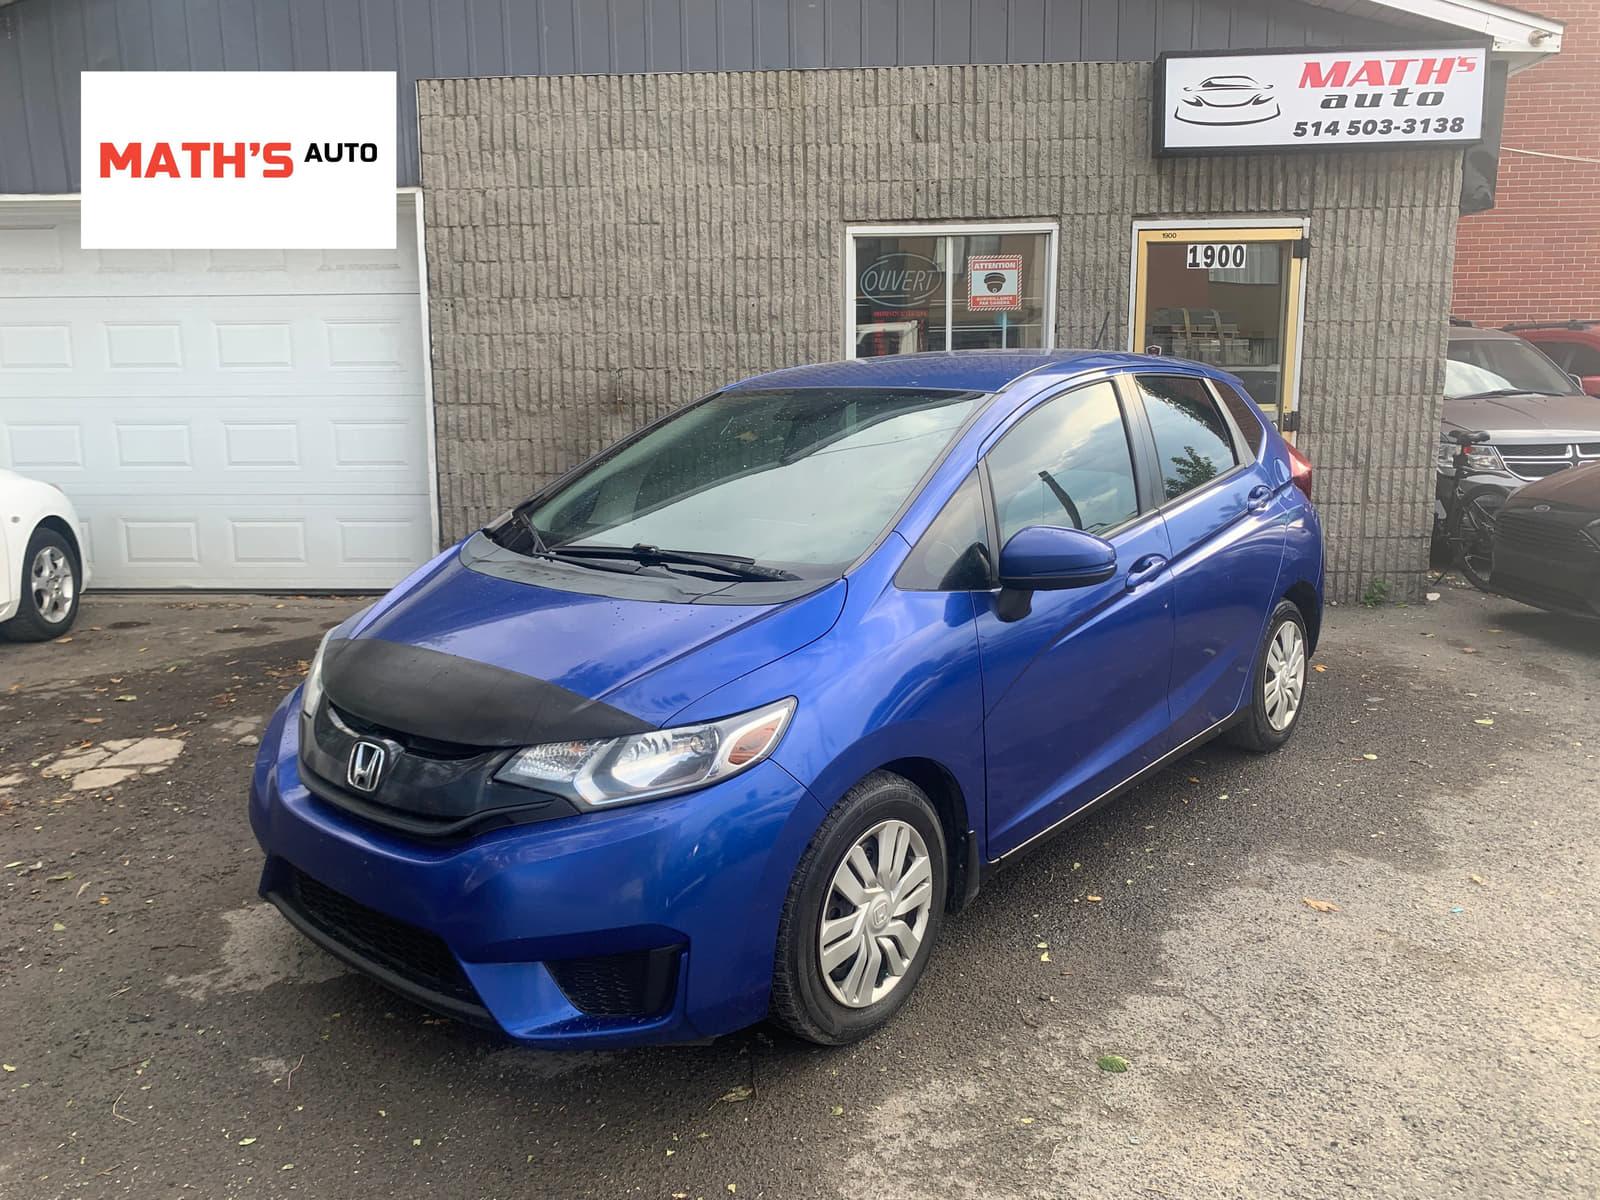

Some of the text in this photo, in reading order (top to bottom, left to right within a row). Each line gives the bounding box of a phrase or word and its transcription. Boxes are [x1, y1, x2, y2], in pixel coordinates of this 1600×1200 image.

[1320, 87, 1445, 109] auto
[1293, 117, 1465, 137] 514 503-3138
[974, 262, 1016, 270] ATTENTION
[1188, 245, 1245, 268] 1900
[864, 270, 937, 291] OUVERT
